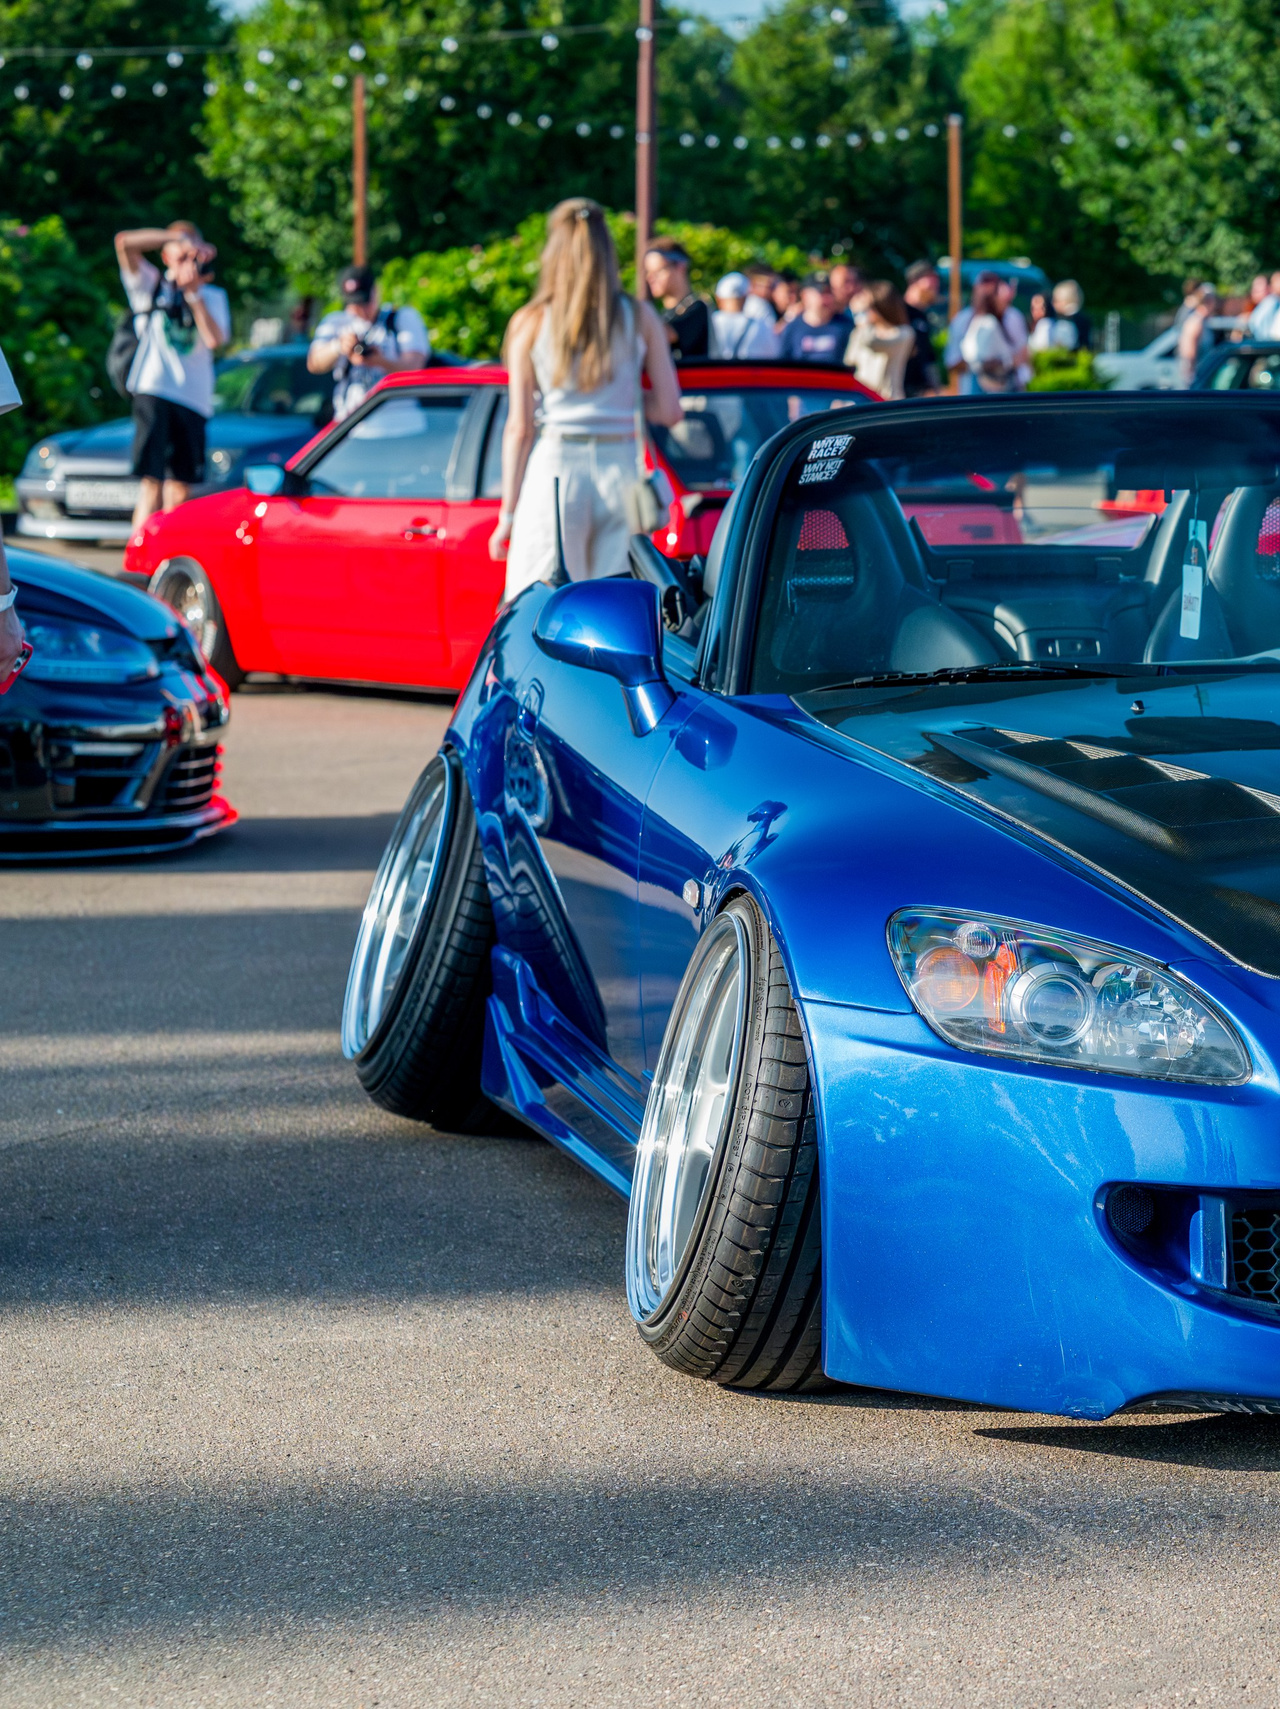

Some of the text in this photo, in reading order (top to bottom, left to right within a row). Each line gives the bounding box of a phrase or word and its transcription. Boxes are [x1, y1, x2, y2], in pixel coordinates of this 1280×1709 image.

[812, 436, 853, 450] WHY NOT
[807, 446, 846, 461] RACE?
[803, 459, 844, 474] WHY NOT
[798, 470, 838, 485] STANCE?
